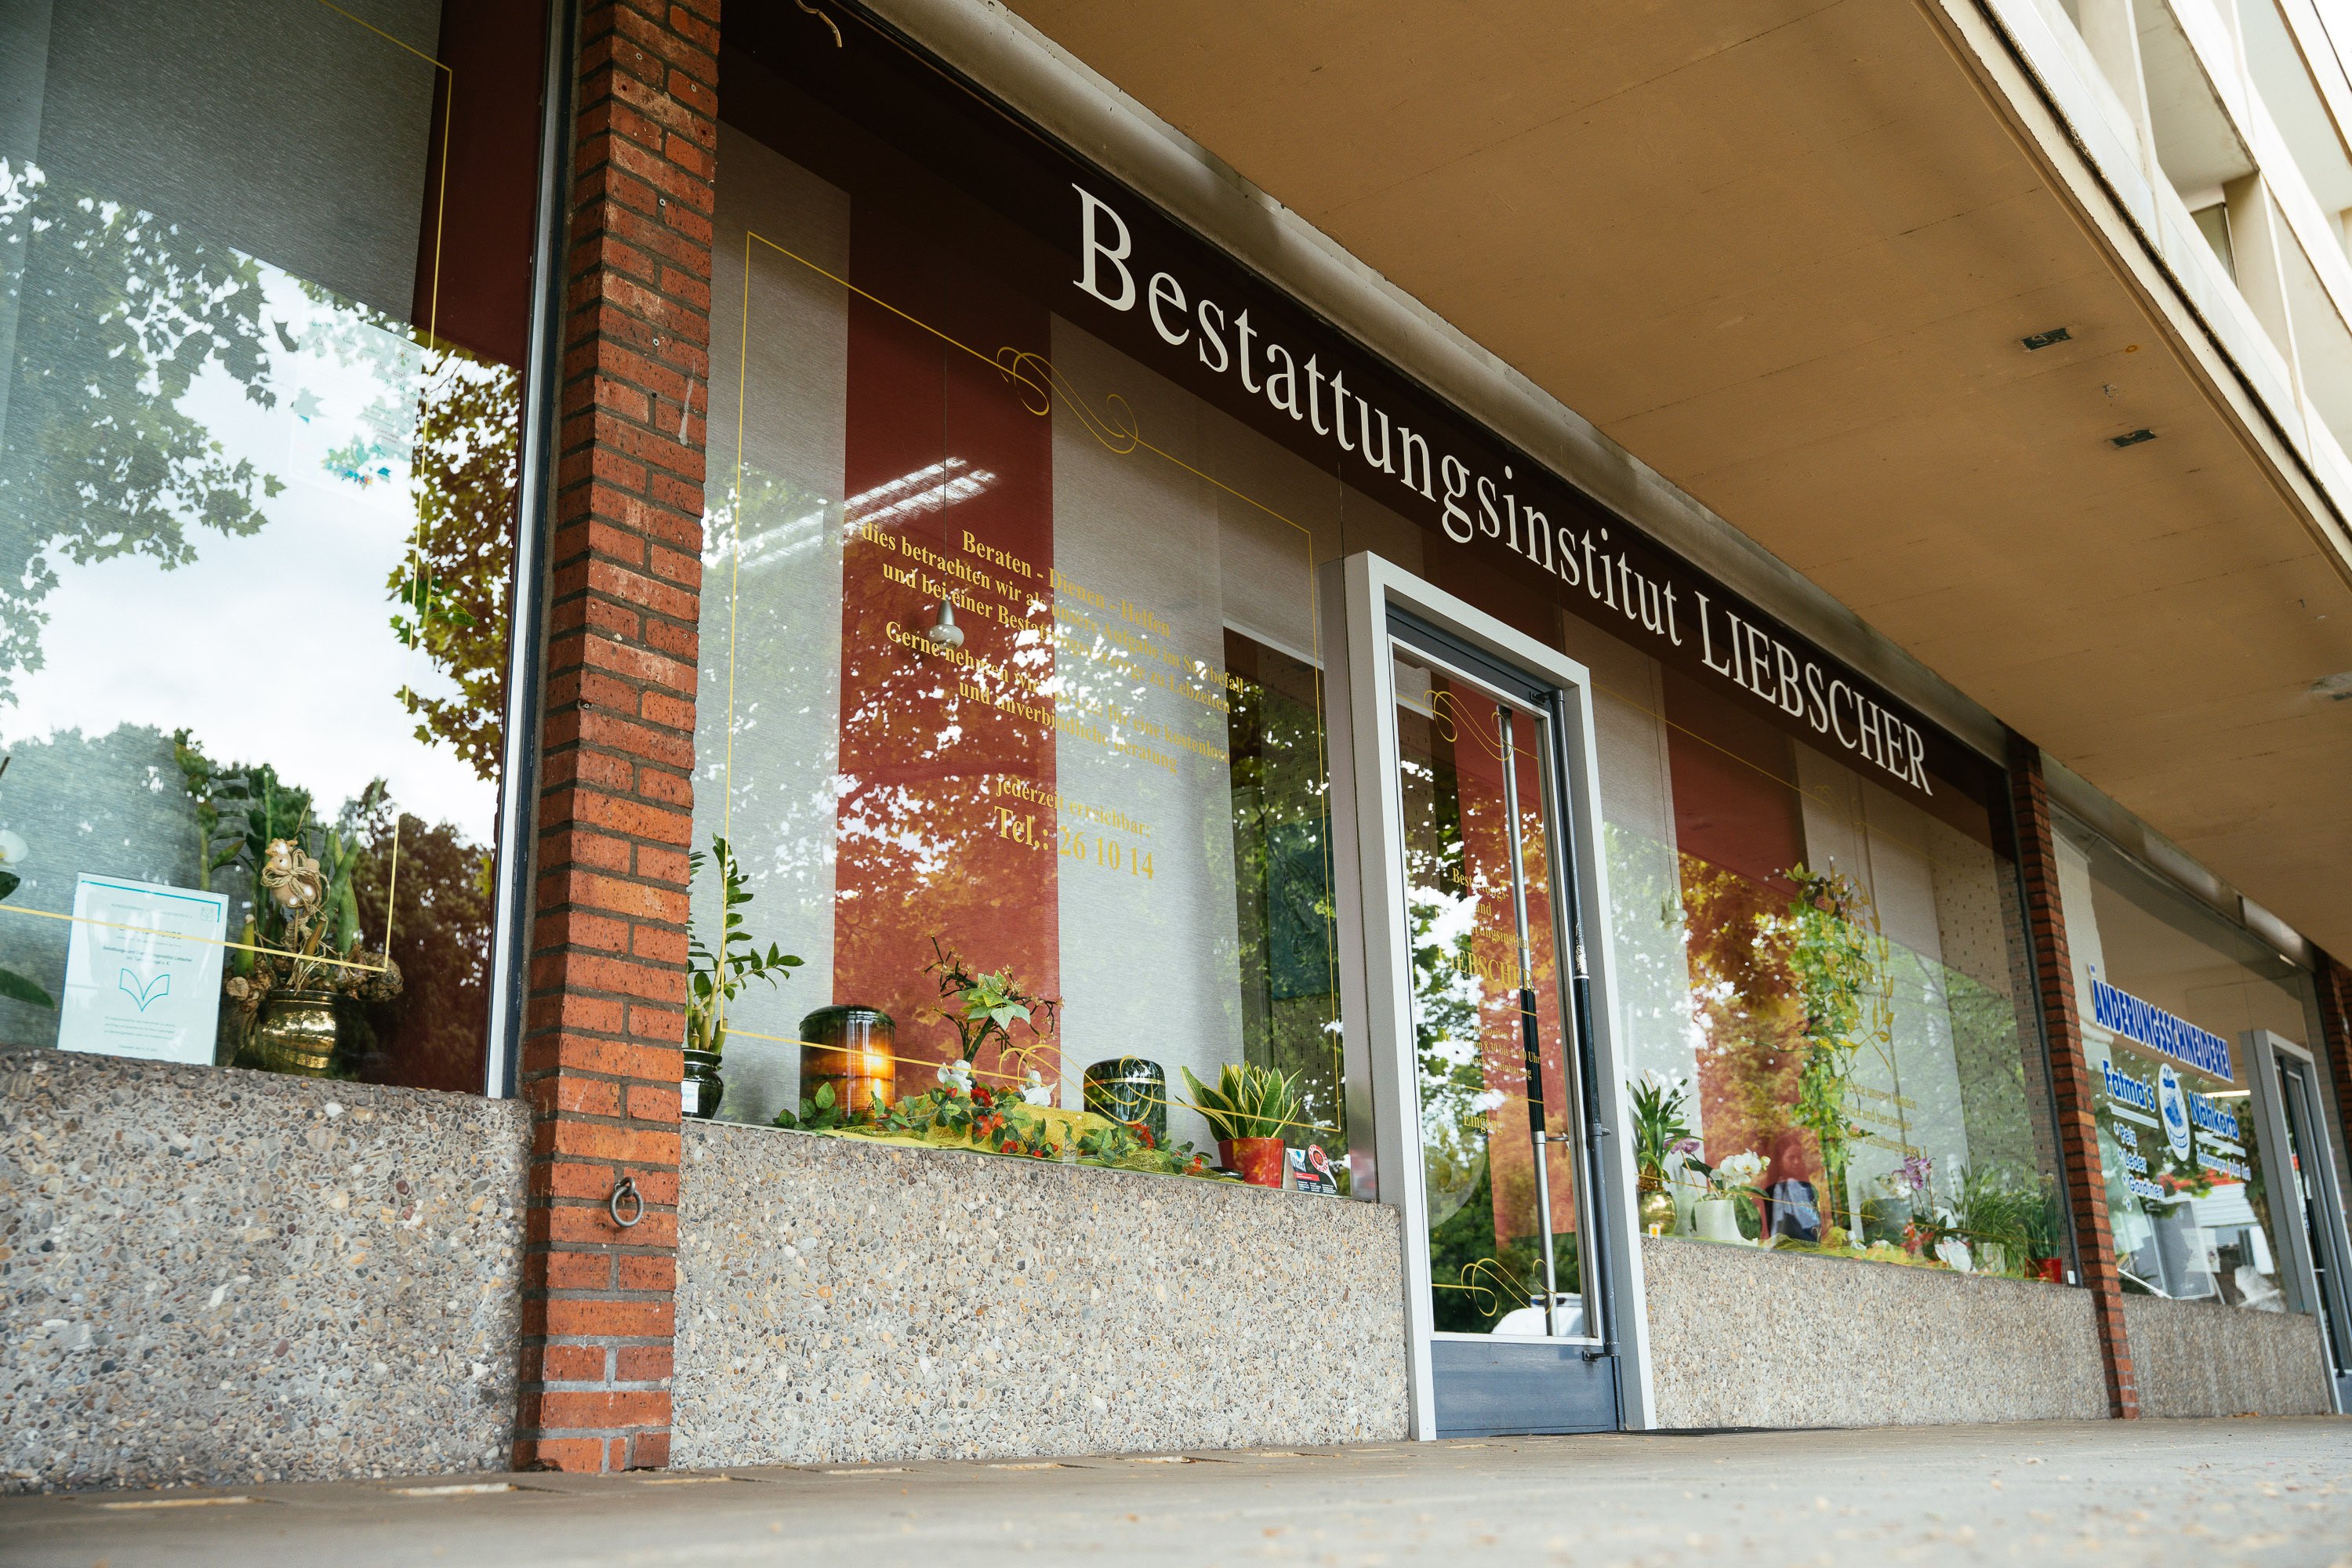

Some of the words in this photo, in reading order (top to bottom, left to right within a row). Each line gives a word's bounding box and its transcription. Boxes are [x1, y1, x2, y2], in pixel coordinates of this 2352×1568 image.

[1072, 183, 1682, 646] Bestattungsinstitut
[1693, 590, 1933, 796] LIEBSCHER
[862, 521, 896, 550] dies
[902, 535, 990, 590] betrachten
[995, 579, 1022, 601] wir
[1051, 603, 1098, 633] unsere
[1102, 622, 1160, 660] Aufgabe
[1163, 647, 1180, 668] im
[1183, 654, 1244, 695] Strbefall
[962, 529, 1032, 579] Beraten
[1048, 567, 1105, 610] Dienen
[1120, 598, 1171, 637] Helfen
[882, 563, 916, 589] und
[922, 573, 947, 601] bei
[952, 589, 993, 618] einer
[997, 603, 1145, 681] Besttngsvrsorge
[1168, 673, 1231, 714] Lebzeiten
[885, 620, 940, 657] Gerne
[945, 647, 1009, 684] nehmen
[1133, 714, 1161, 739] eine
[1164, 723, 1230, 765] kostenlose
[959, 681, 991, 706] und
[994, 805, 1049, 851] Tel.:
[1058, 825, 1087, 861] 26
[1095, 837, 1121, 871] 10
[1130, 848, 1154, 880] 14
[996, 773, 1065, 812] jederzeit
[1069, 799, 1151, 838] erreichbar:
[1452, 867, 1509, 902] Bestugs-
[1528, 1051, 1541, 1065] Uhr
[2090, 964, 2234, 1083] ÄNDERUNGSSCHNEIDEREI
[2102, 1059, 2157, 1113] Fatma's
[2187, 1089, 2240, 1142] Nähkorb
[2122, 1148, 2148, 1174] Leder
[2128, 1174, 2165, 1200] Gardinen
